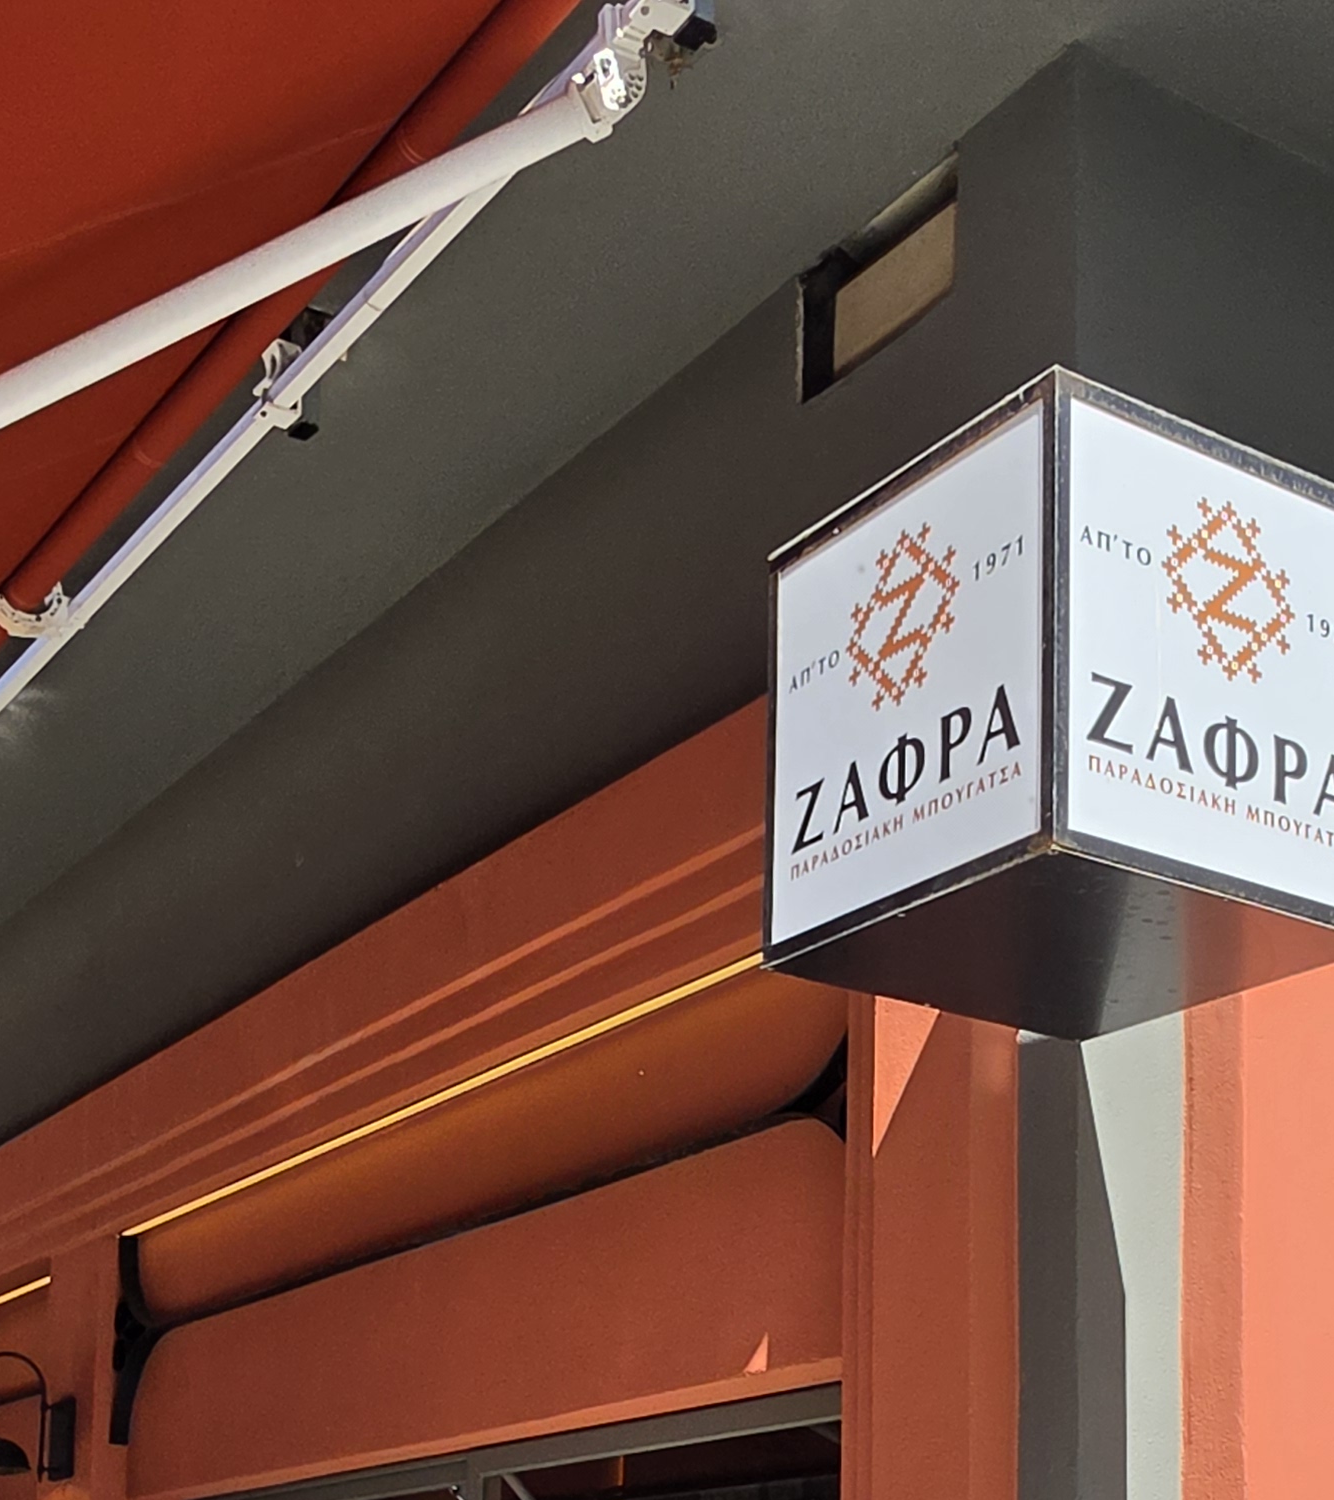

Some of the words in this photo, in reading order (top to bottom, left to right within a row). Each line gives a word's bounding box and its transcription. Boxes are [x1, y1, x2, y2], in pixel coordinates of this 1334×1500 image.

[972, 535, 1025, 581] 1971
[790, 683, 1022, 856] ΖΑΦΡΑ
[1088, 754, 1237, 816] ΠΑΡΑΔΟΣΙΑΚΗ
[790, 813, 904, 881] ΠΑΡΑΔΟΣΙΑΚΗ
[912, 761, 1022, 824] ΜΠΟΥΓΑΤΣΑ
